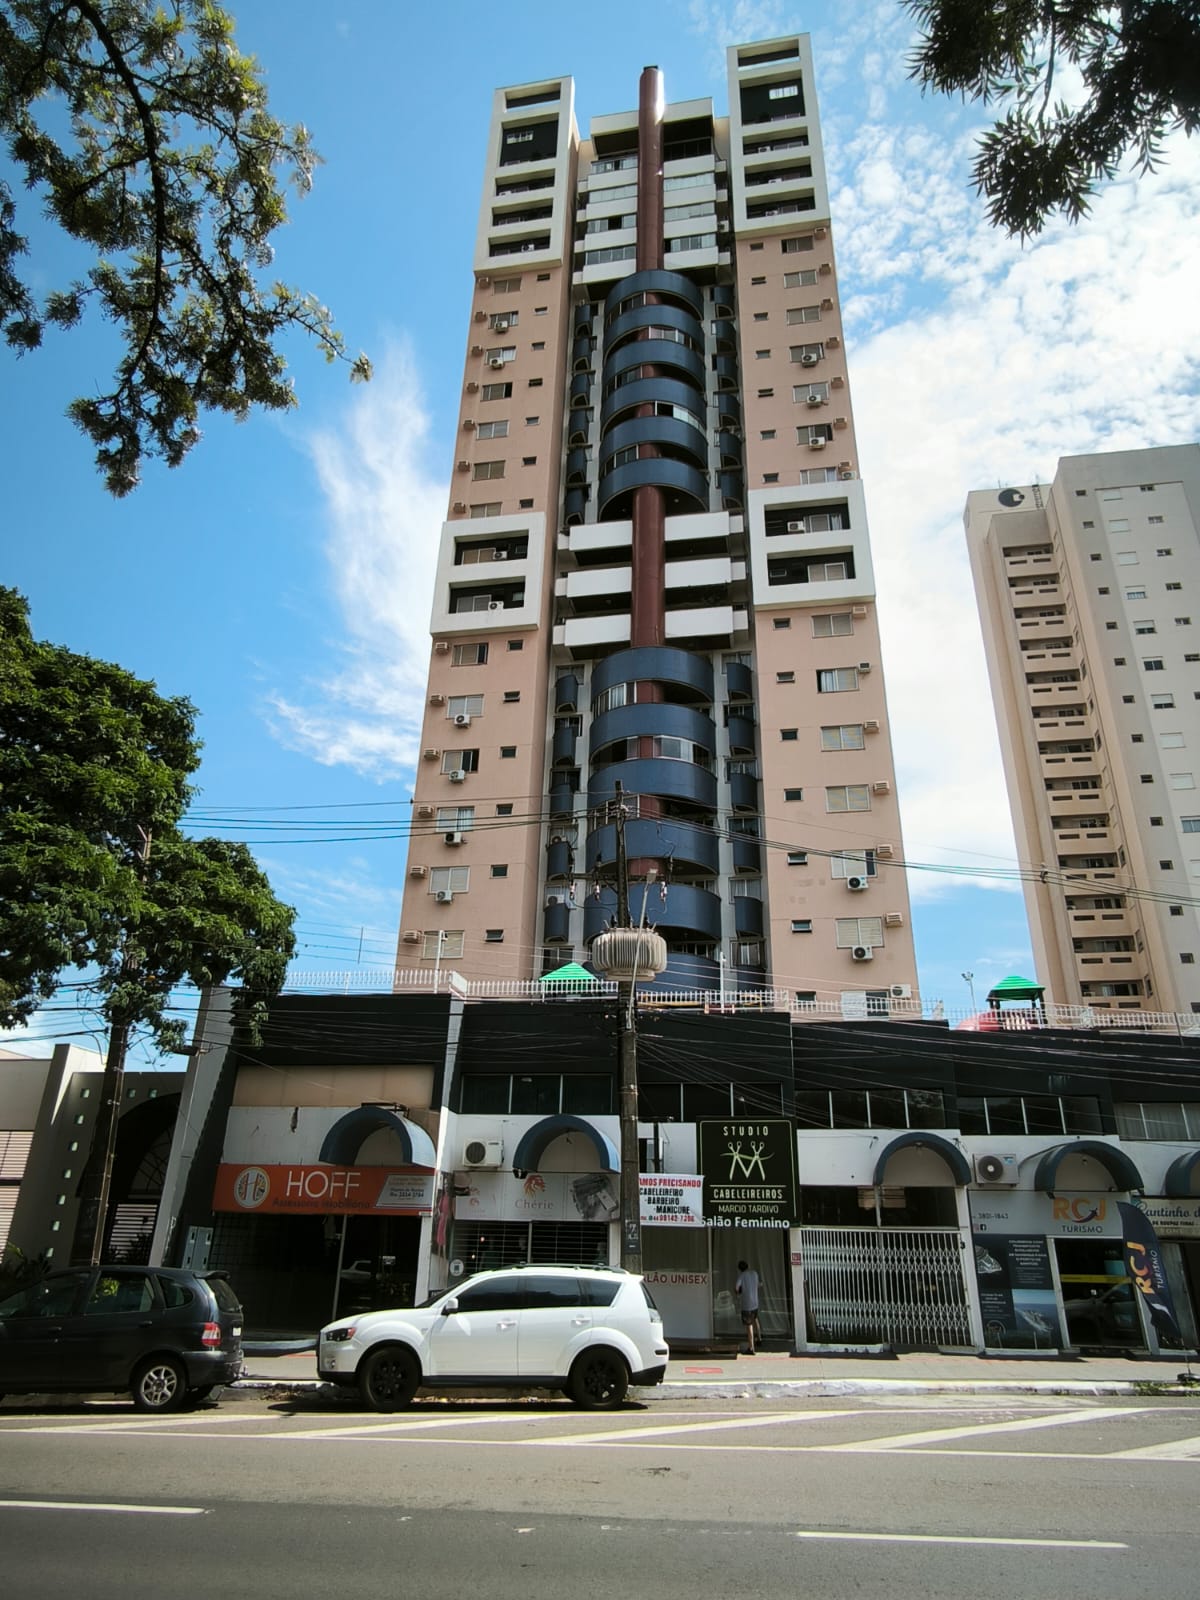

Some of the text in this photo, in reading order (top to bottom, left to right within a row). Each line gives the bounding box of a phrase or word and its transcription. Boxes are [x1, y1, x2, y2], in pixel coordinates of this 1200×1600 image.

[723, 1126, 769, 1136] STUDIO
[286, 1170, 361, 1198] HOFF
[659, 1178, 702, 1188] PRECISANDO
[713, 1188, 784, 1200] CABELEIREIROS
[514, 1199, 554, 1210] Chérie
[718, 1204, 779, 1214] MARCIO TARDIVO
[1052, 1196, 1107, 1224] RCJ
[735, 1216, 790, 1229] Feminino
[1062, 1225, 1103, 1234] TURISMO
[671, 1274, 708, 1285] UNISEX
